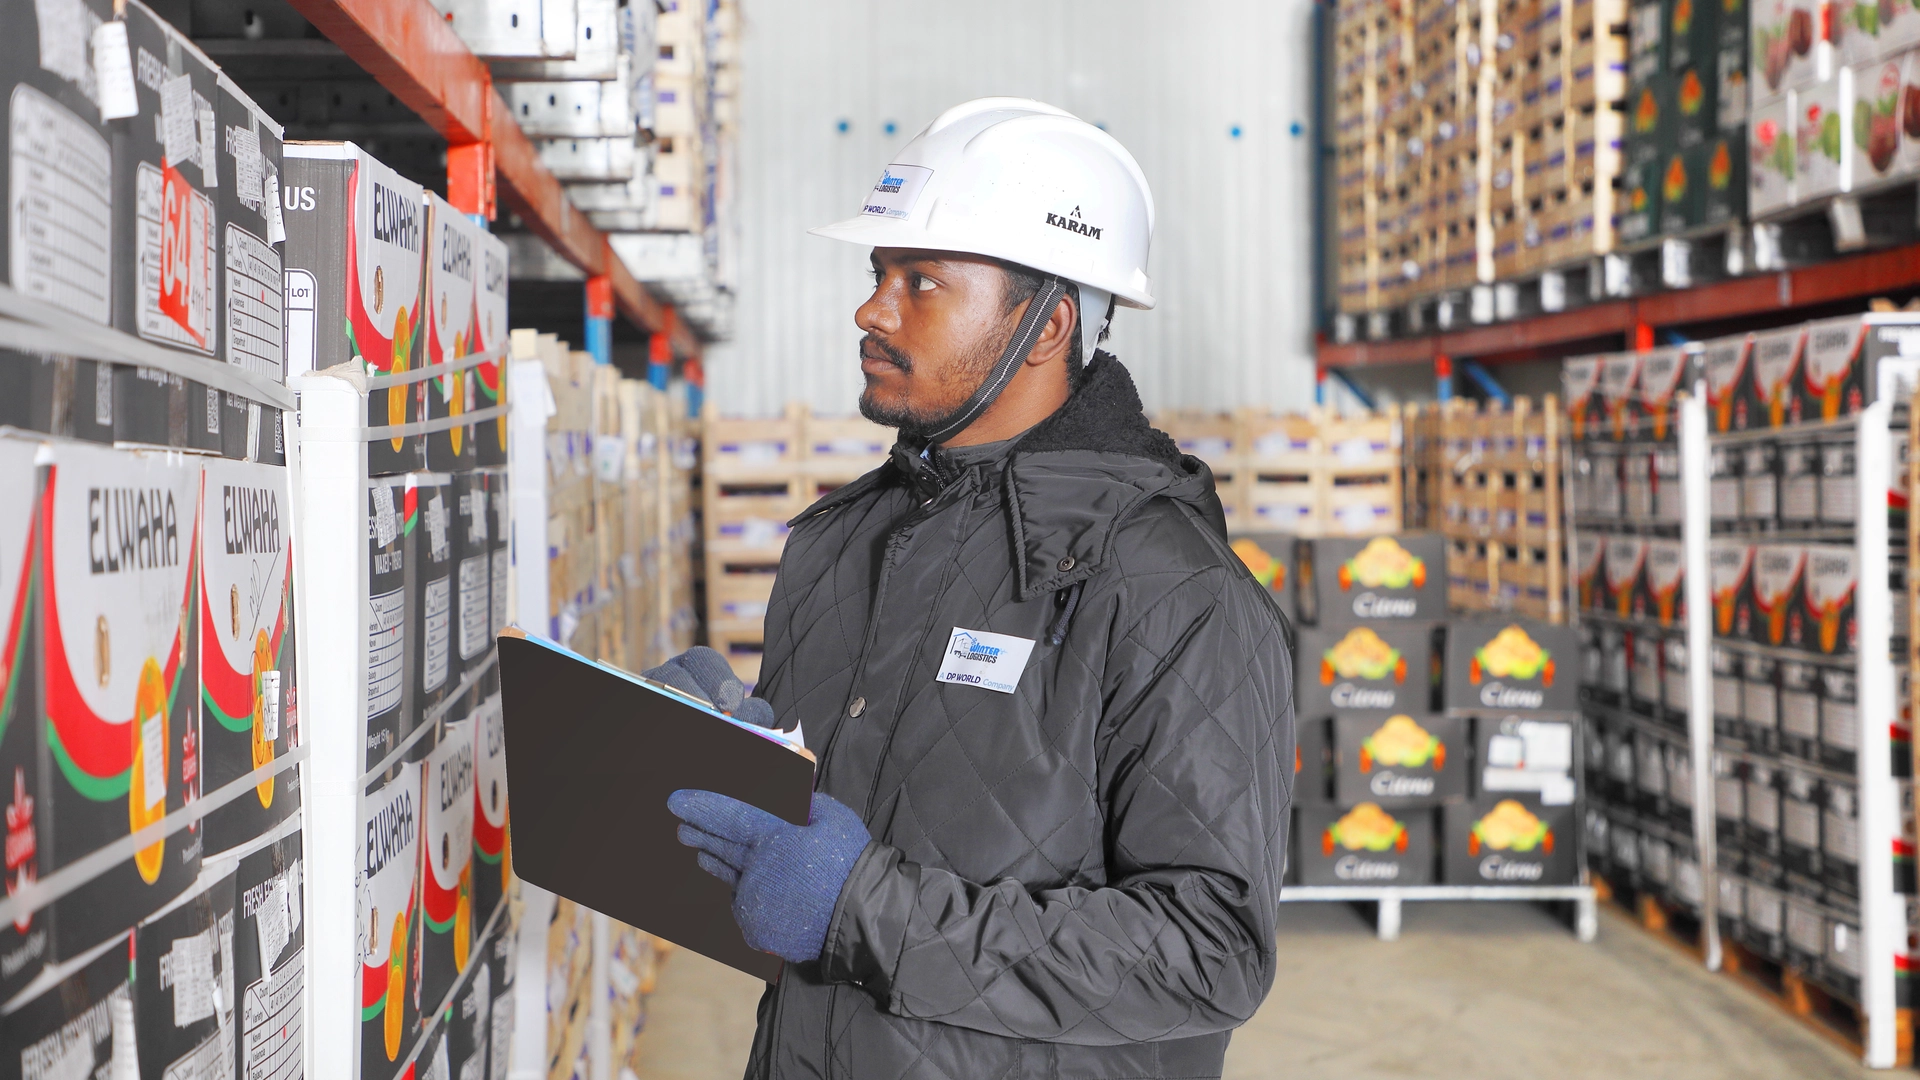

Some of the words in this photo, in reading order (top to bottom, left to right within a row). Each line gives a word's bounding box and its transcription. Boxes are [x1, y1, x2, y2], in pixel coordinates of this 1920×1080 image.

[878, 185, 901, 194] LOGISTICS
[374, 182, 418, 254] ELWAHA
[868, 205, 886, 214] WORLD
[886, 208, 908, 218] Company
[1046, 212, 1101, 240] KARAM
[162, 179, 188, 308] 64
[291, 288, 310, 299] LOT
[89, 487, 179, 576] ELWAHA
[223, 485, 280, 555] ELWAHA
[966, 652, 998, 664] LOGISTICS
[946, 672, 956, 681] DP
[956, 673, 981, 684] WORLD
[982, 678, 1015, 692] Company
[367, 789, 414, 879] ELWAHA
[244, 883, 264, 920] FRESH
